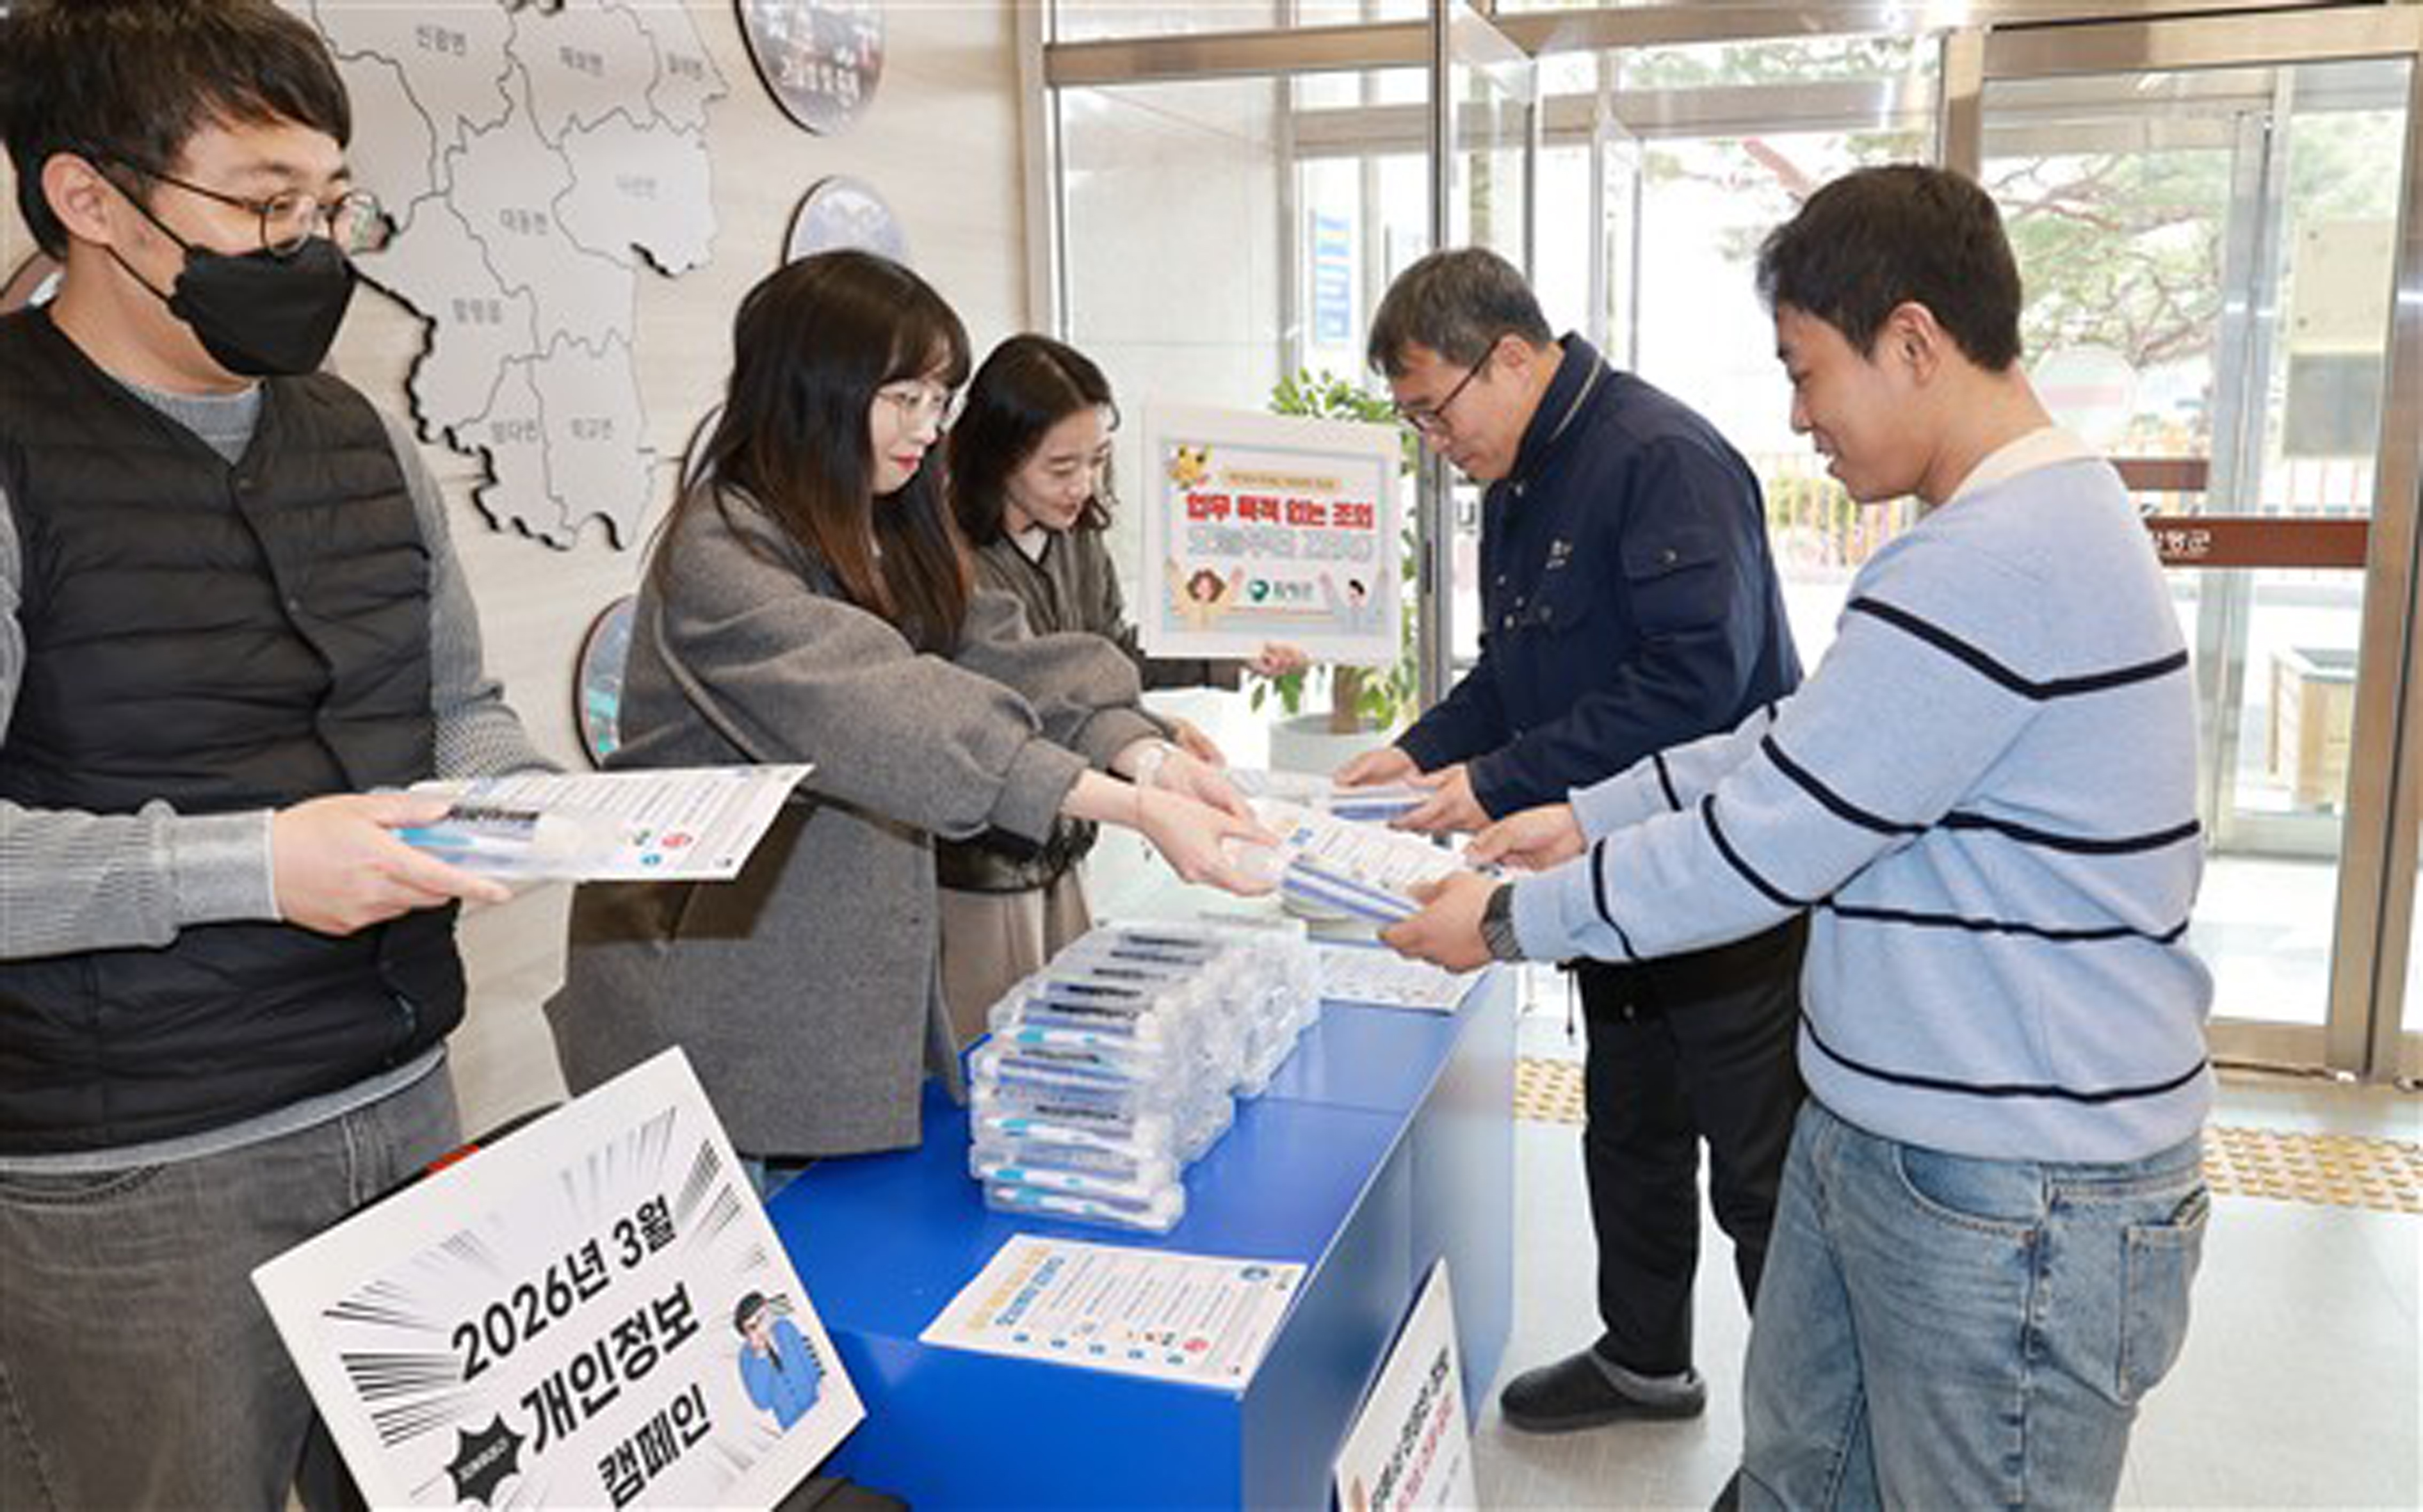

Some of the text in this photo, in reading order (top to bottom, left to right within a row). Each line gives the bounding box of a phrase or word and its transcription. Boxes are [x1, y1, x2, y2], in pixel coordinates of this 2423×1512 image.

[1187, 492, 1231, 521] 업무
[1237, 495, 1279, 522] 목적
[1286, 499, 1326, 527] 없는
[451, 1194, 677, 1381] 2026년 3월
[520, 1282, 700, 1454] 개인정보
[597, 1383, 711, 1511] 캠페인
